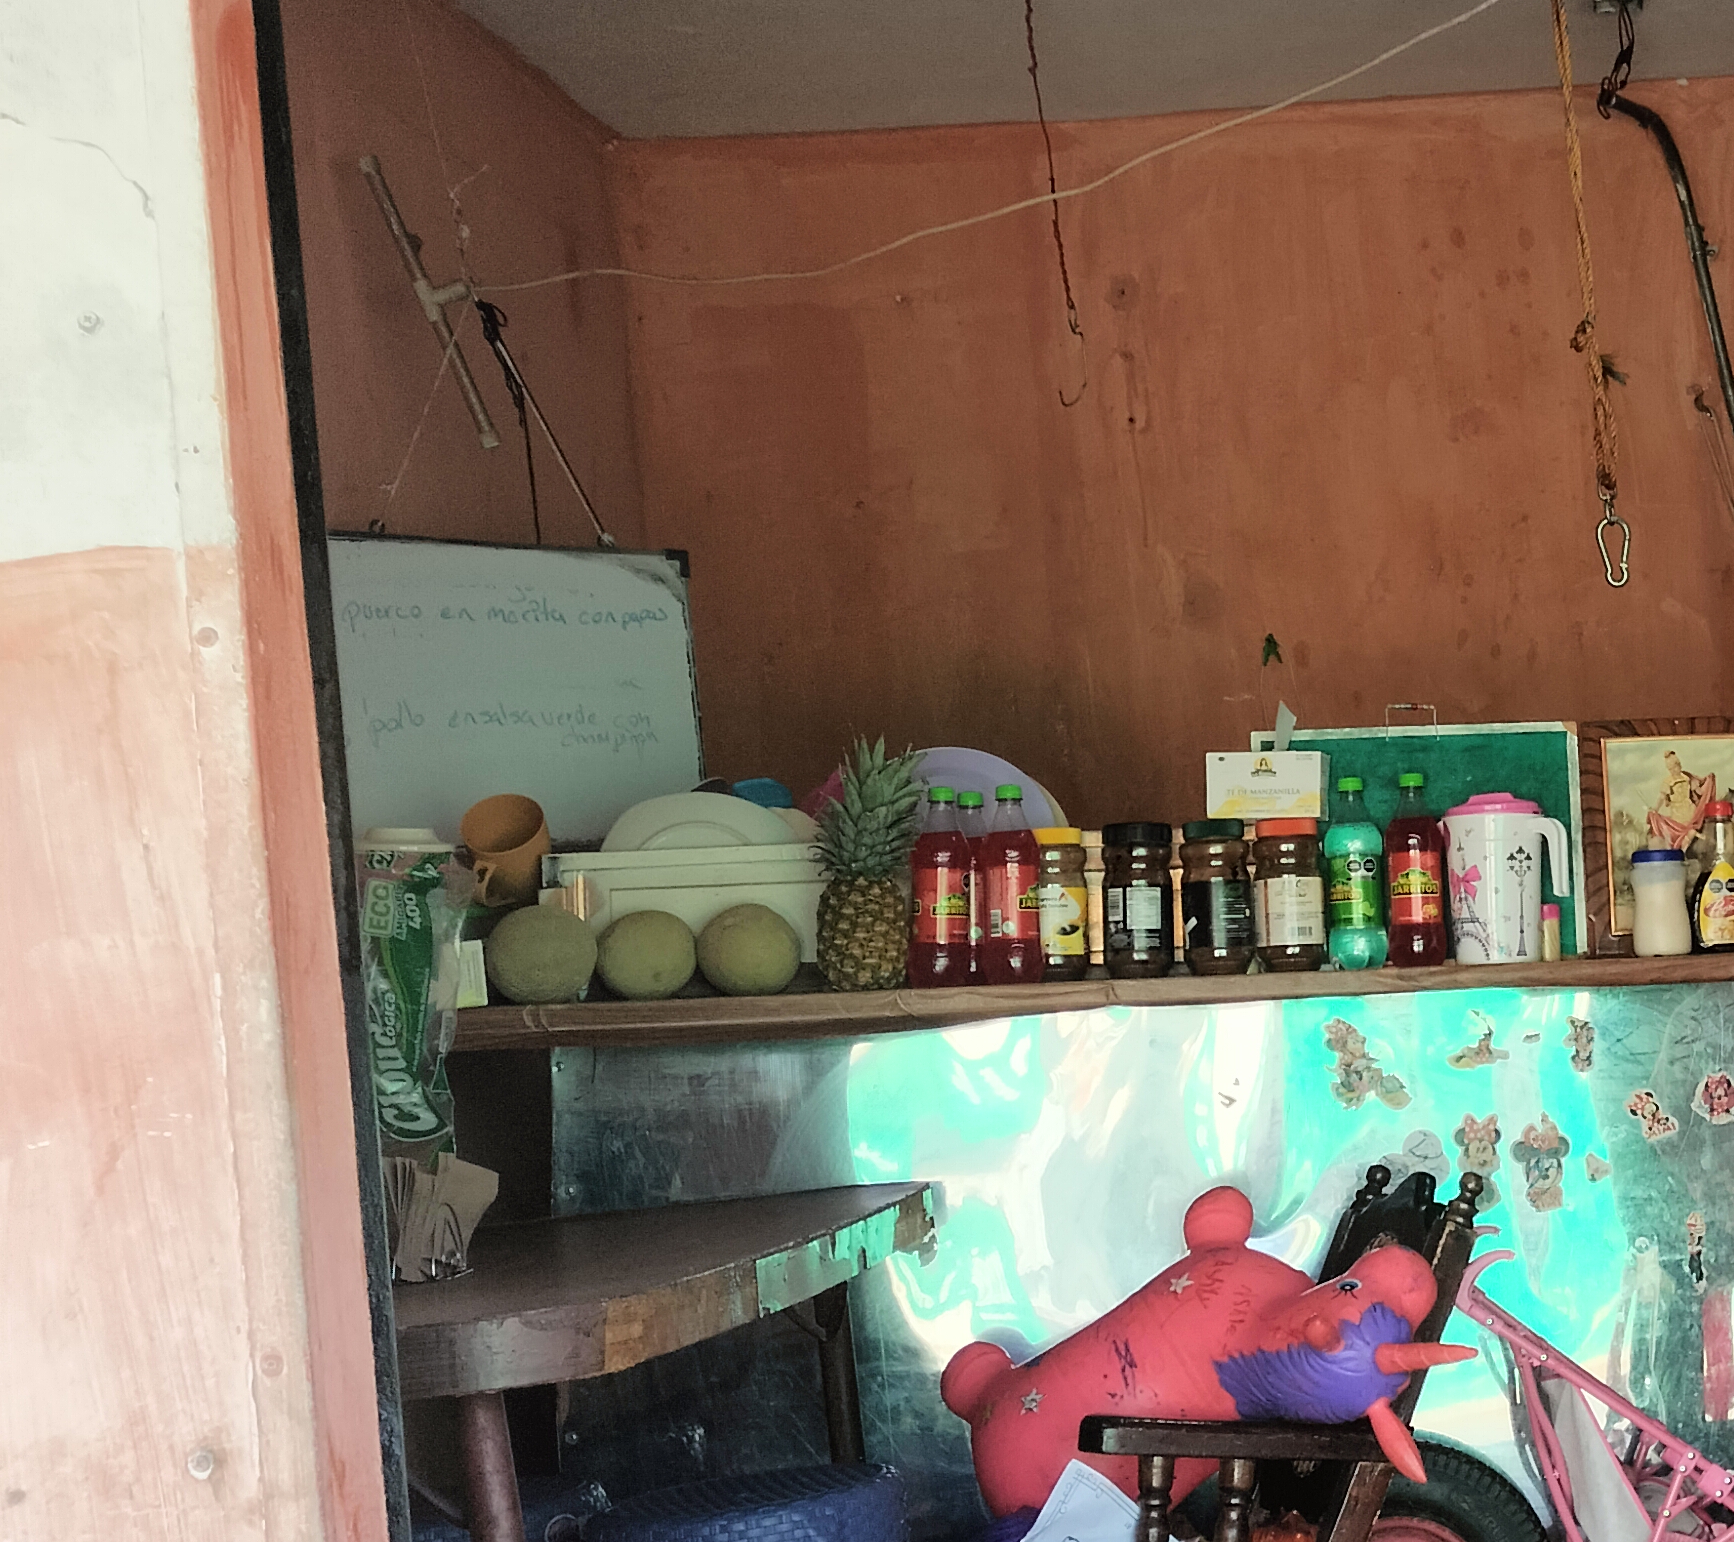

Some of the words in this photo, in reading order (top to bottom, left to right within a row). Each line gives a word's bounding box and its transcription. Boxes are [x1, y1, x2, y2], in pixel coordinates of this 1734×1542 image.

[440, 607, 475, 623] en
[579, 609, 617, 626] con
[1249, 788, 1302, 796] MANZANILLA
[1393, 884, 1439, 895] JARRITOS
[367, 884, 391, 932] ECO
[403, 892, 423, 930] 400
